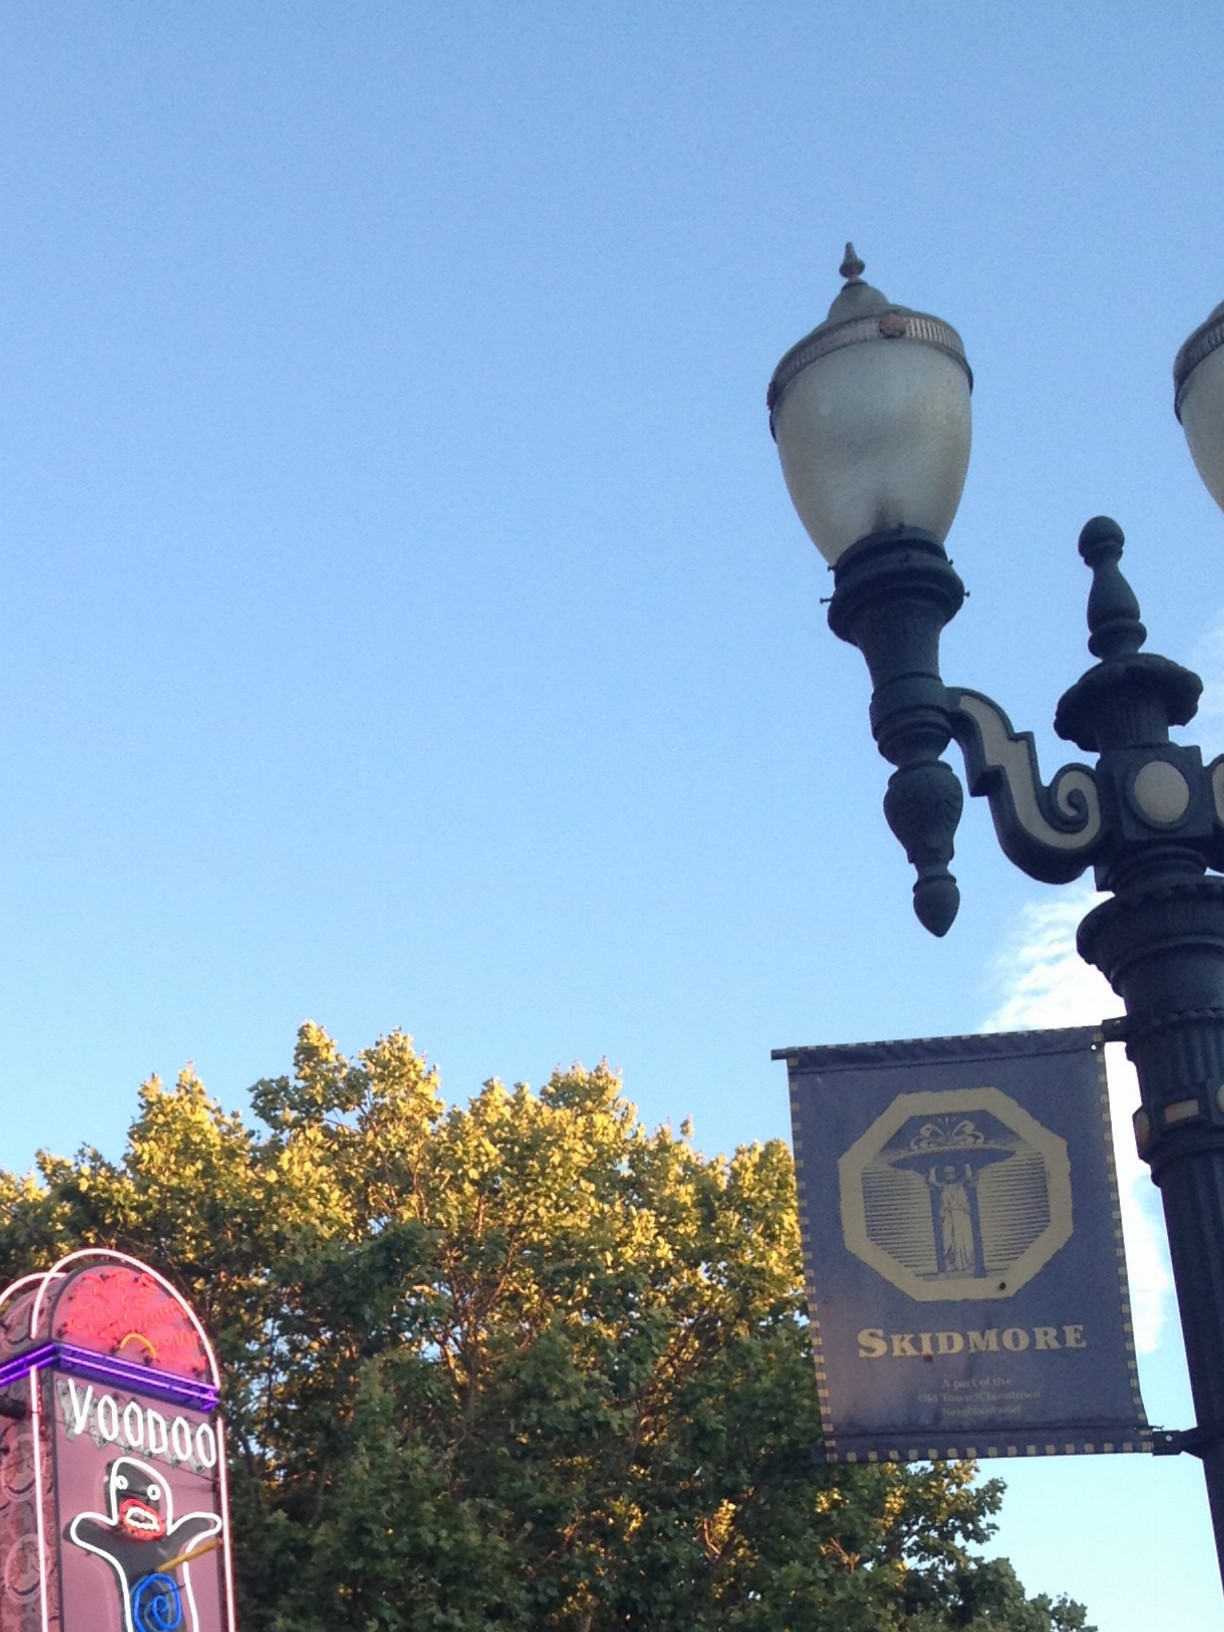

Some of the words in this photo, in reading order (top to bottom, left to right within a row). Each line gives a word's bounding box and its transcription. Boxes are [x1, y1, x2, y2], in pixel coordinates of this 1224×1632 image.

[953, 1378, 977, 1392] part
[992, 1375, 1013, 1386] the
[67, 1378, 218, 1469] VOODOO
